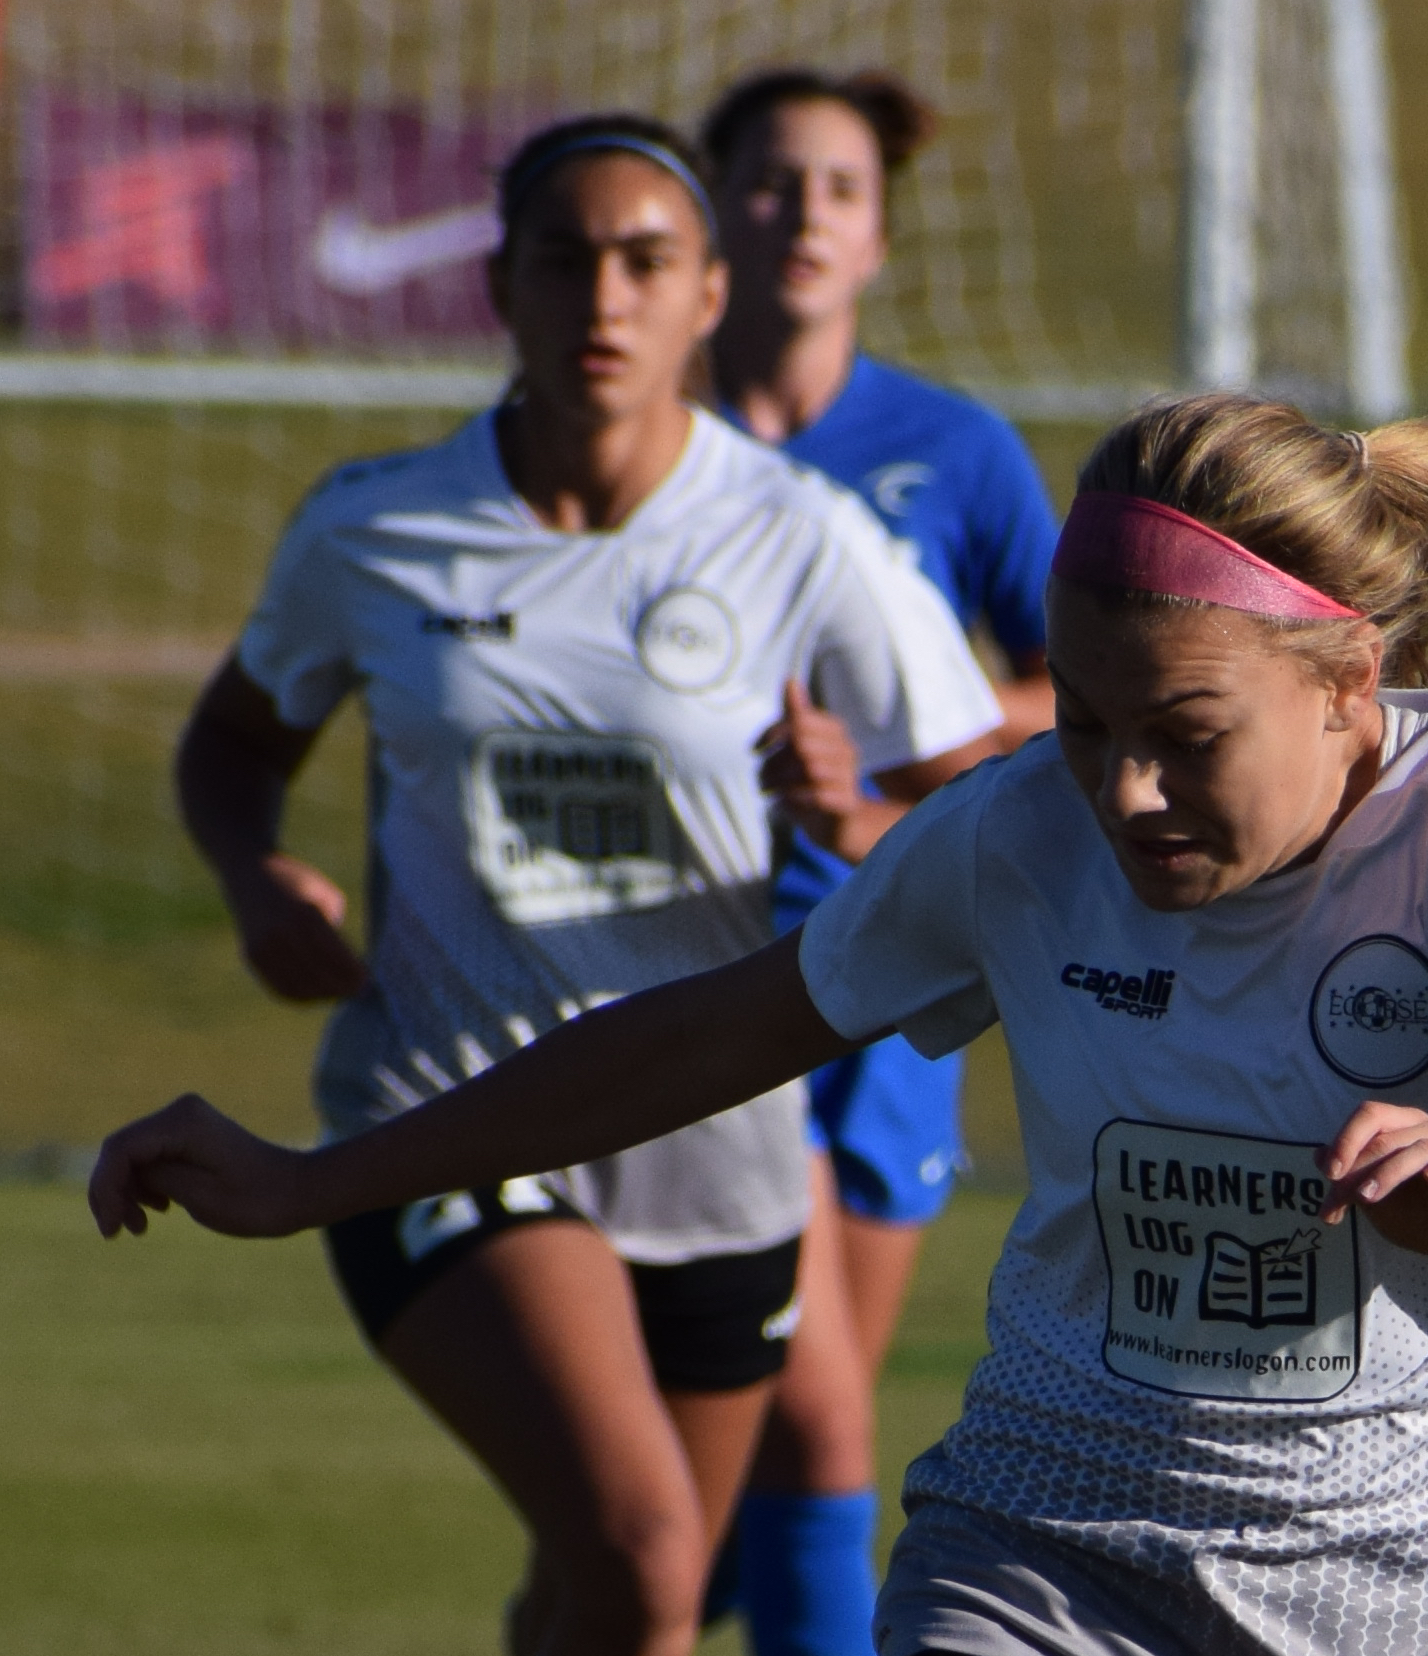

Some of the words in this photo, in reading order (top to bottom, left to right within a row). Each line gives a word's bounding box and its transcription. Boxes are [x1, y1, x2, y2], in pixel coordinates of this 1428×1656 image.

[1061, 963, 1175, 1006] capelli
[1101, 997, 1168, 1019] SPORT
[1120, 1150, 1325, 1217] LEARNERS
[1123, 1213, 1194, 1256] LOG
[1134, 1269, 1180, 1320] ON
[1108, 1328, 1351, 1375] www.learnerslogon.com
